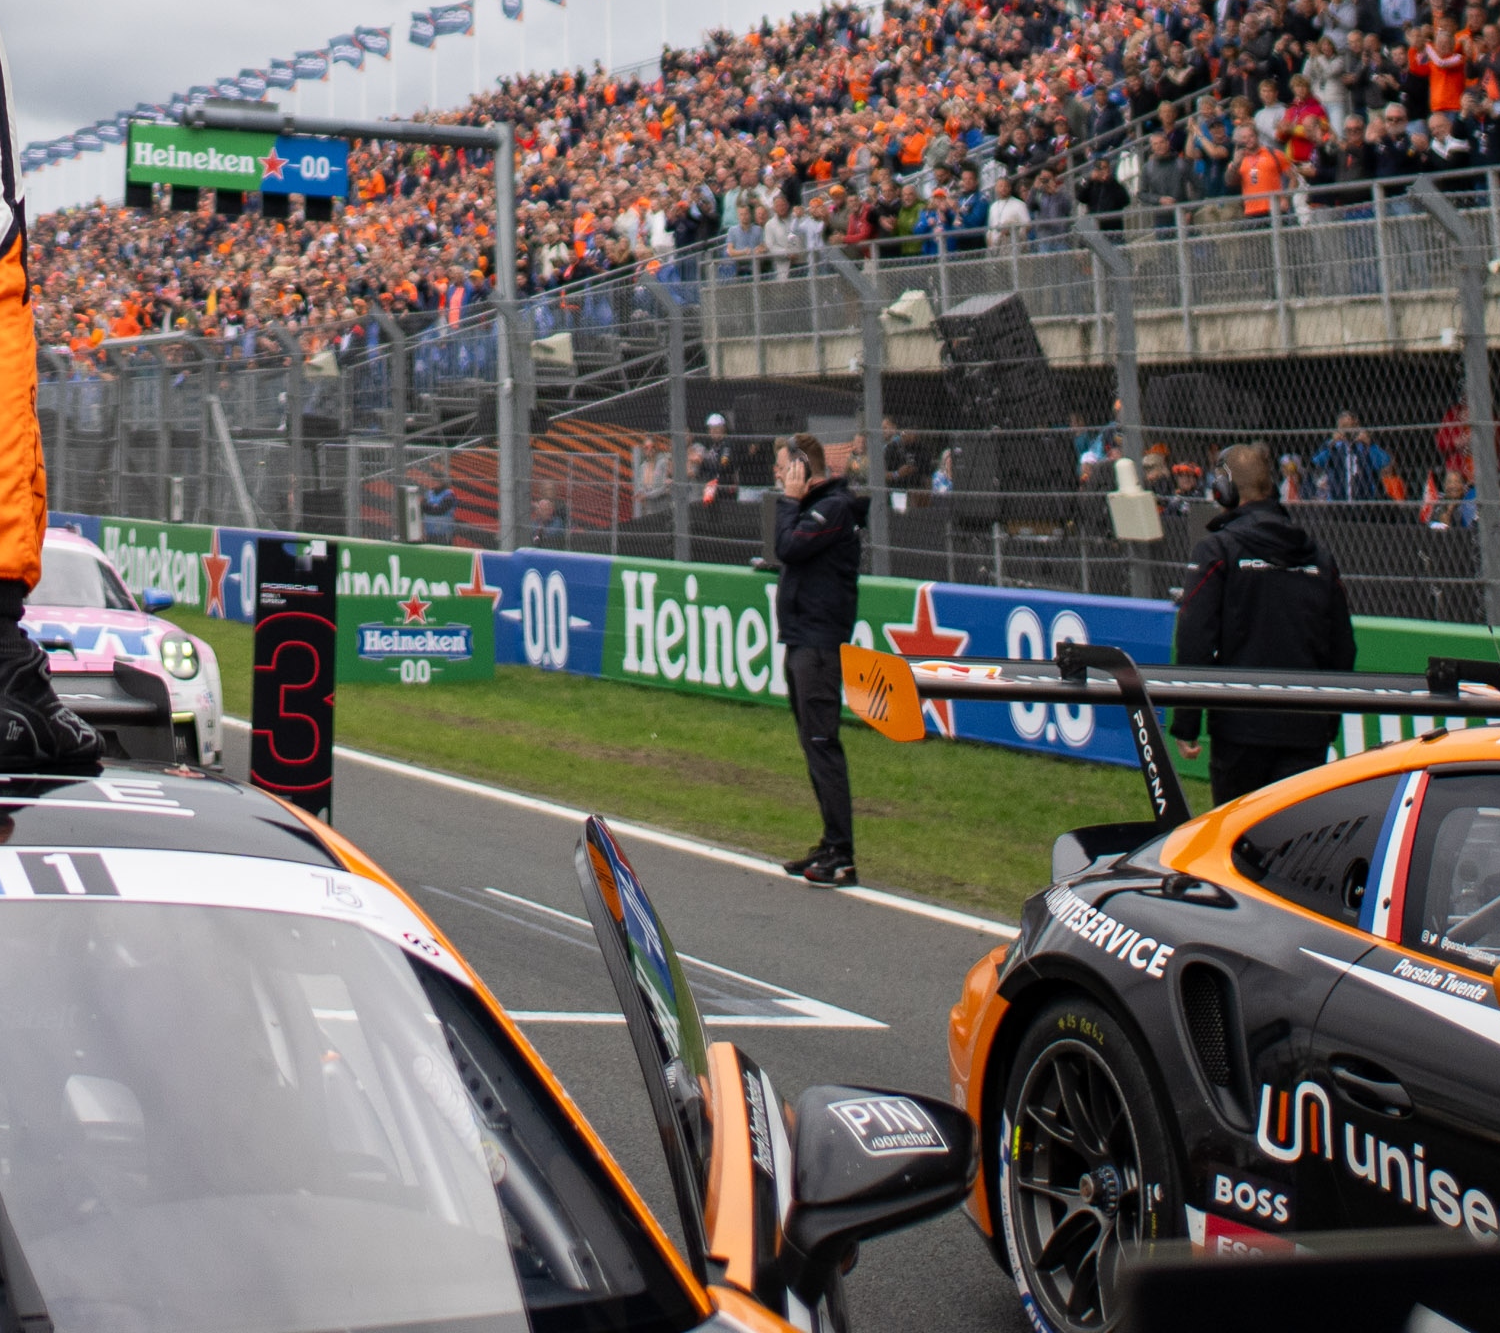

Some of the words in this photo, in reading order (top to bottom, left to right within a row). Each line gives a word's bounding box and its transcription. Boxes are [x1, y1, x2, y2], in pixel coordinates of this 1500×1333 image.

[133, 141, 256, 175] Heineken
[103, 526, 200, 605] Heineken
[260, 582, 319, 592] PORSCHE
[363, 630, 467, 652] Heineken
[622, 570, 873, 699] Heine
[252, 611, 338, 790] 3
[1392, 957, 1444, 987] Porsche
[1440, 969, 1488, 1002] Twente
[843, 1098, 925, 1135] PIN
[1214, 1173, 1290, 1223] BOSS
